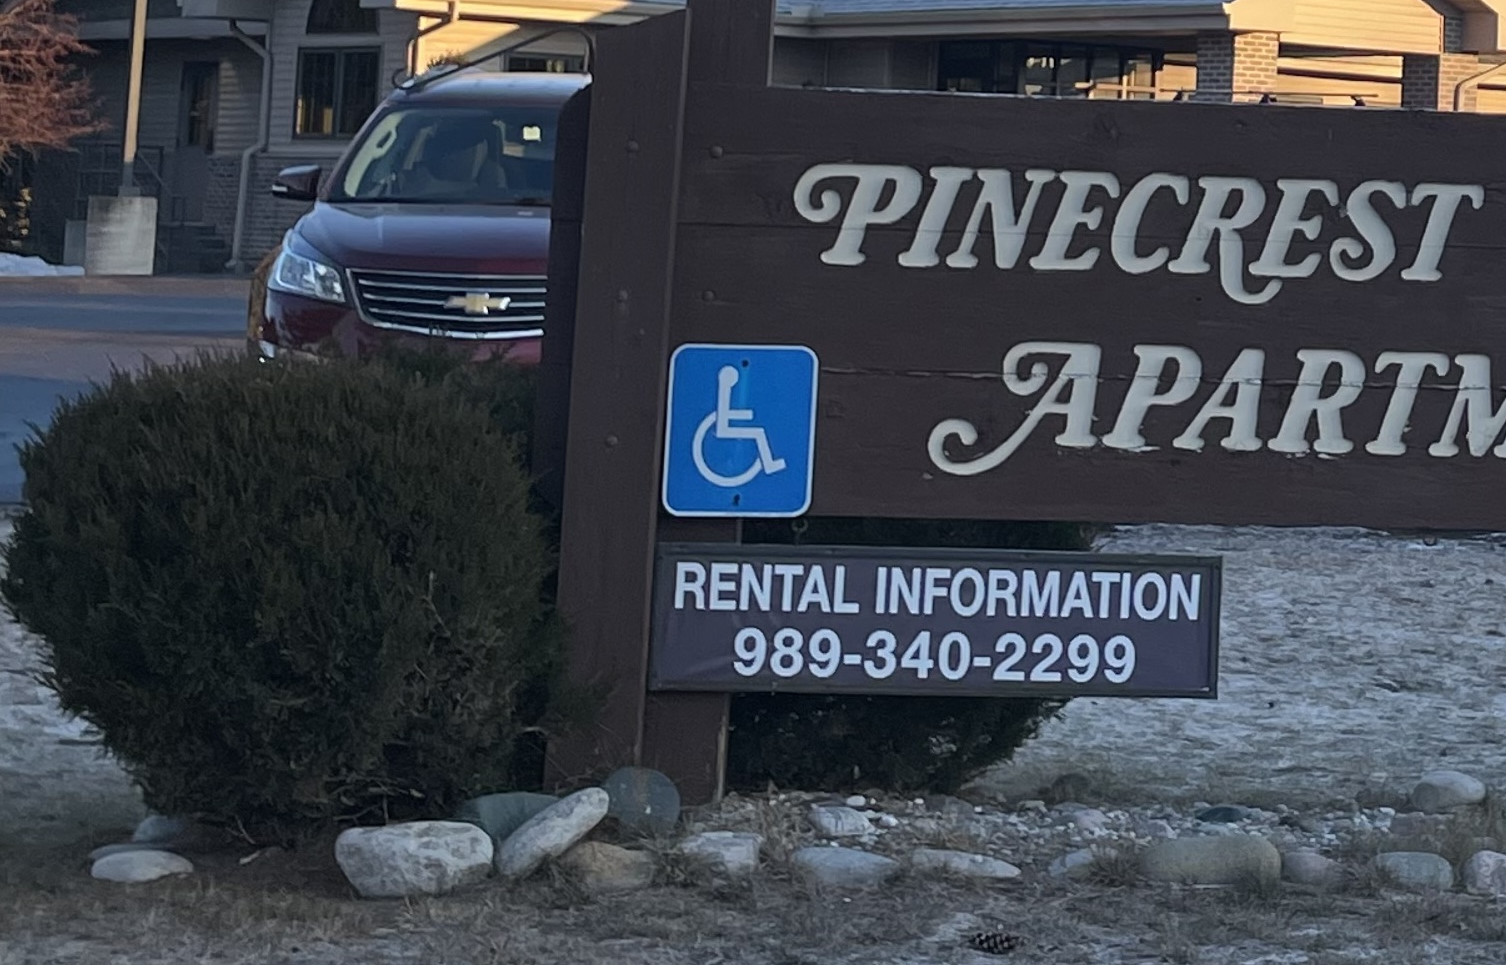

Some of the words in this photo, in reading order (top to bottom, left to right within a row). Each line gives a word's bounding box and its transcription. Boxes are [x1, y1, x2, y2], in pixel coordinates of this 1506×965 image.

[793, 164, 1484, 305] PINECREST
[674, 561, 860, 614] RENTAL
[875, 566, 1201, 621] INFORMATION
[733, 627, 1136, 684] 989-340-2299
